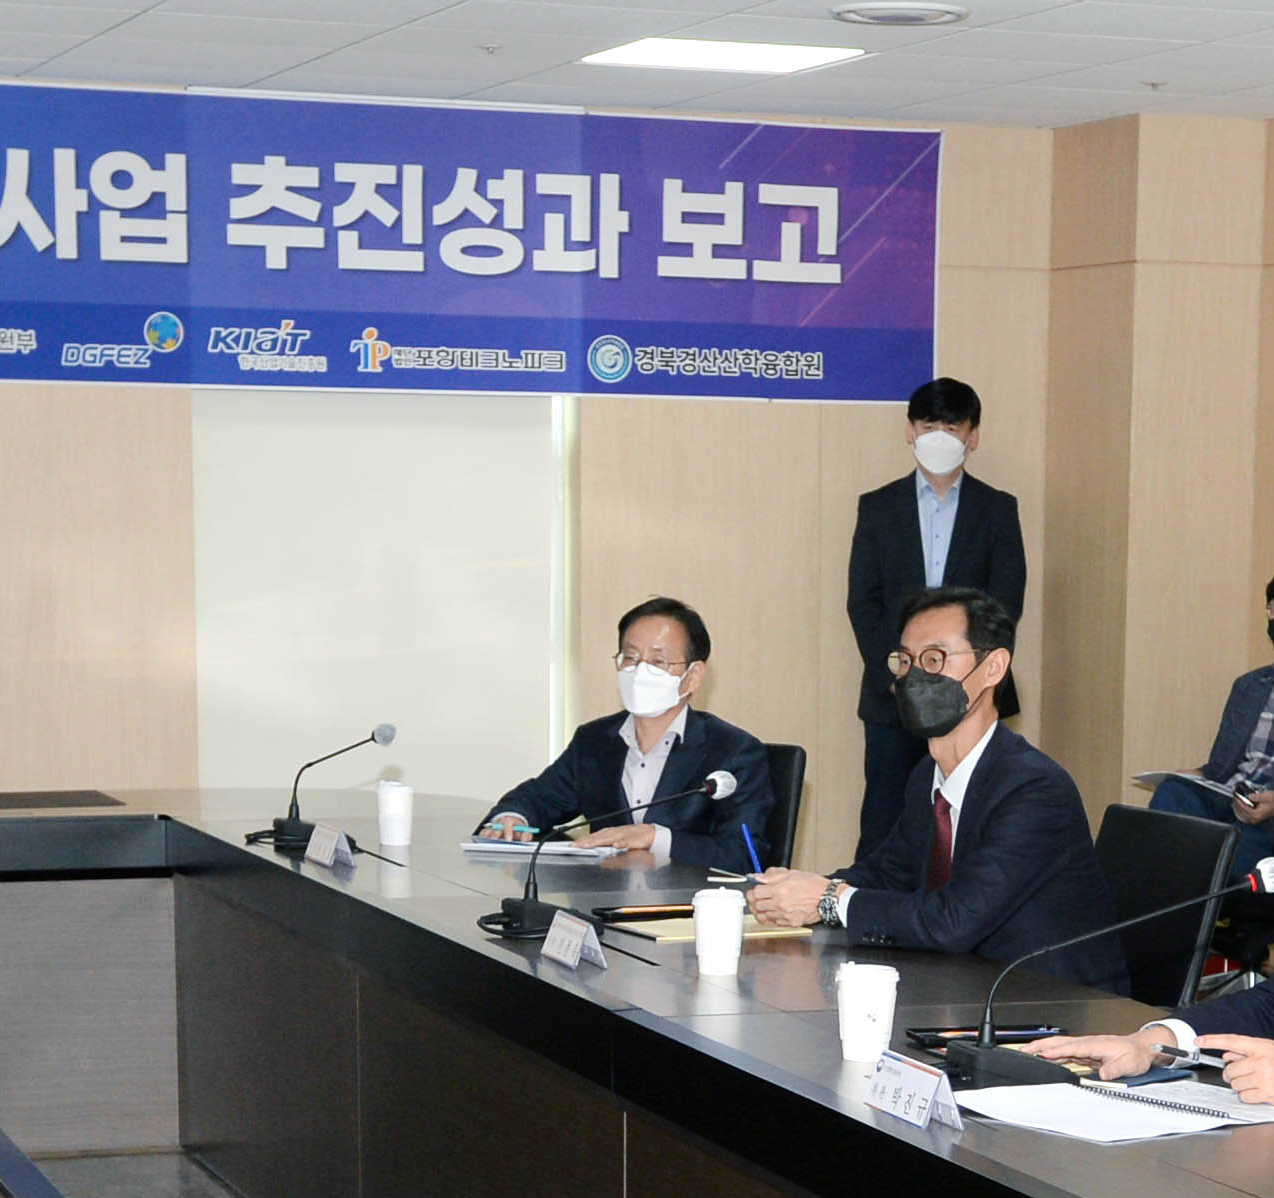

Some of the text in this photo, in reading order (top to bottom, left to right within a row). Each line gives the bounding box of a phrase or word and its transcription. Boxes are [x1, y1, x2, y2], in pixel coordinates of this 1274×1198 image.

[226, 155, 629, 282] 추진성과
[656, 177, 843, 286] 보고
[61, 344, 151, 368] DGFEZ
[413, 348, 566, 372] 포항테크노파크
[635, 346, 824, 380] 경북경산산학융합원
